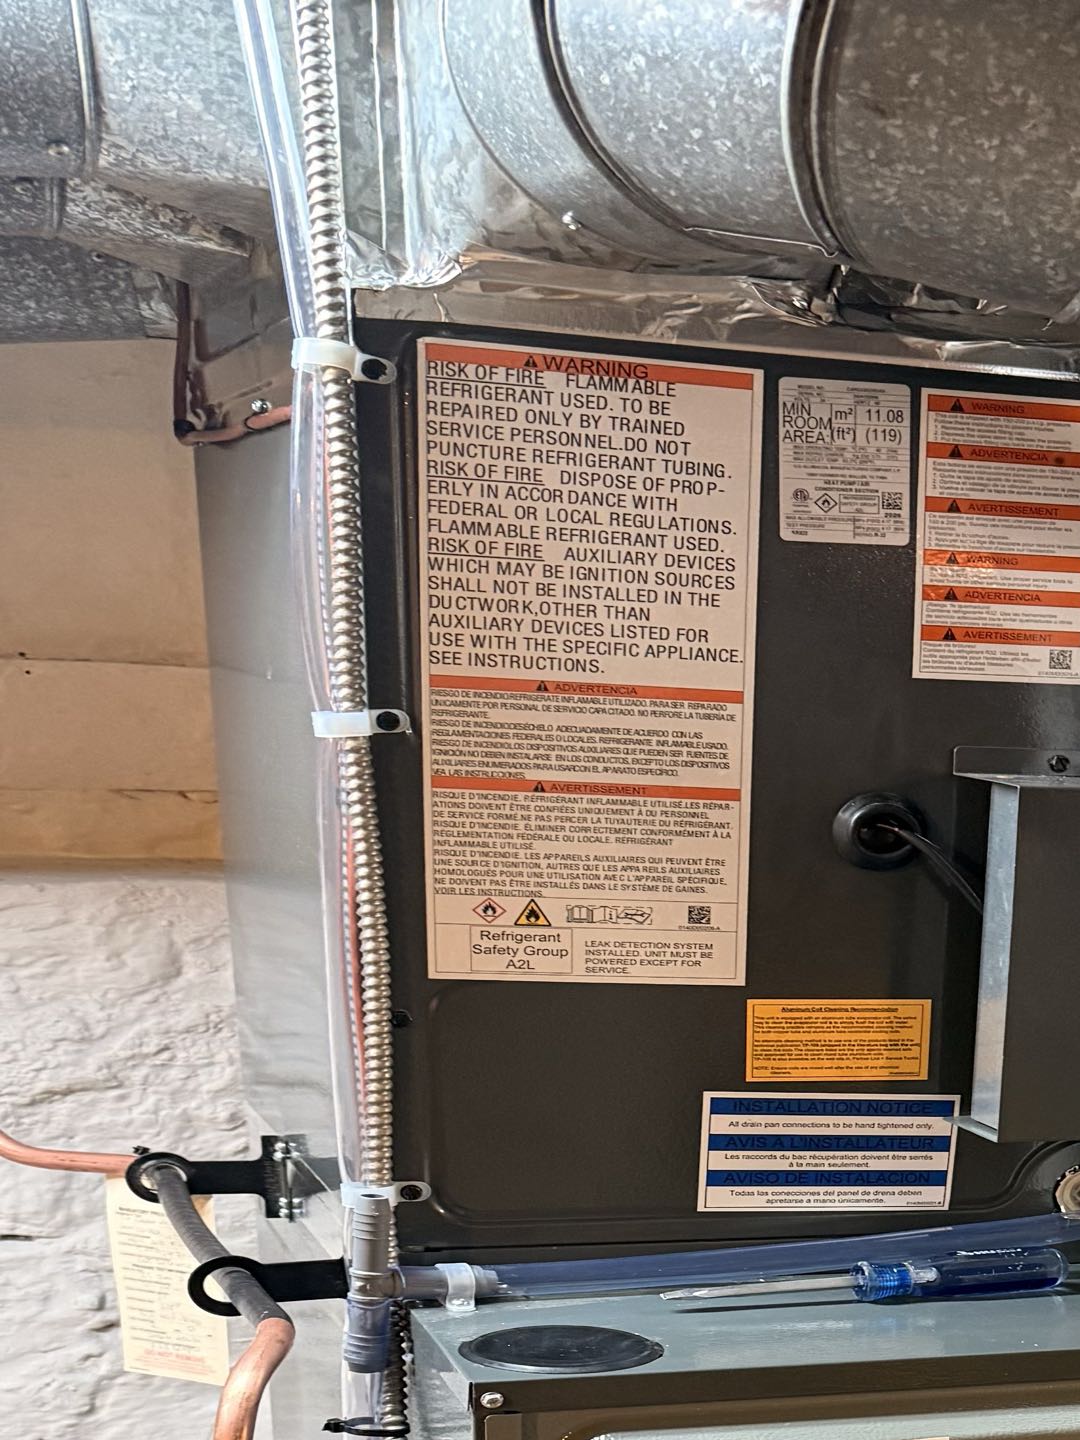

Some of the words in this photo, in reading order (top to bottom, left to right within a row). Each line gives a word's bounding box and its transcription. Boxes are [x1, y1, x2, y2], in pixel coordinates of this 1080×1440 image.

[543, 355, 649, 378] WARNING
[427, 361, 470, 377] RISK
[475, 365, 498, 379] OF
[505, 367, 545, 385] FIRE
[566, 375, 676, 397] FLAMMABLE
[427, 381, 554, 406] REFRIGERANT
[560, 393, 614, 410] USED.
[620, 398, 643, 412] TO
[650, 401, 671, 416] BE
[783, 402, 811, 416] MIN
[971, 401, 1025, 415] WARNING
[427, 402, 518, 422] REPAIRED
[525, 410, 573, 427] ONLY
[580, 415, 601, 428] BY
[608, 416, 685, 436] TRAINED
[783, 416, 832, 430] ROOM
[866, 409, 904, 423] 11.08
[427, 421, 505, 440] SERVICE
[655, 439, 692, 455] NOT
[782, 430, 830, 444] AREA:
[866, 427, 902, 445] (119)
[970, 448, 1048, 462] ADVERTENCIA
[968, 502, 1059, 517] AVERTISSEMENT
[967, 555, 1018, 566] WARNING
[964, 591, 1041, 602] ADVERTENCIA
[963, 630, 1052, 642] AVERTISSEMENT
[554, 683, 637, 696] ADVERTENCIA
[550, 783, 648, 795] AVERTISSEMENT
[480, 930, 561, 944] Refrigerant
[472, 944, 520, 957] Safety
[524, 946, 569, 959] Group
[585, 940, 609, 948] LEAK
[613, 941, 670, 949] DETECTION
[673, 942, 713, 950] SYSTEM
[585, 949, 641, 957] INSTALLED.
[670, 951, 697, 959] MUST
[700, 951, 713, 959] BE
[506, 960, 535, 970] A2L
[733, 1101, 862, 1114] INSTALLATION
[867, 1102, 933, 1114] NOTICE
[782, 1121, 830, 1129] connections
[843, 1121, 853, 1129] be
[877, 1122, 914, 1131] tightened
[916, 1122, 934, 1131] only.
